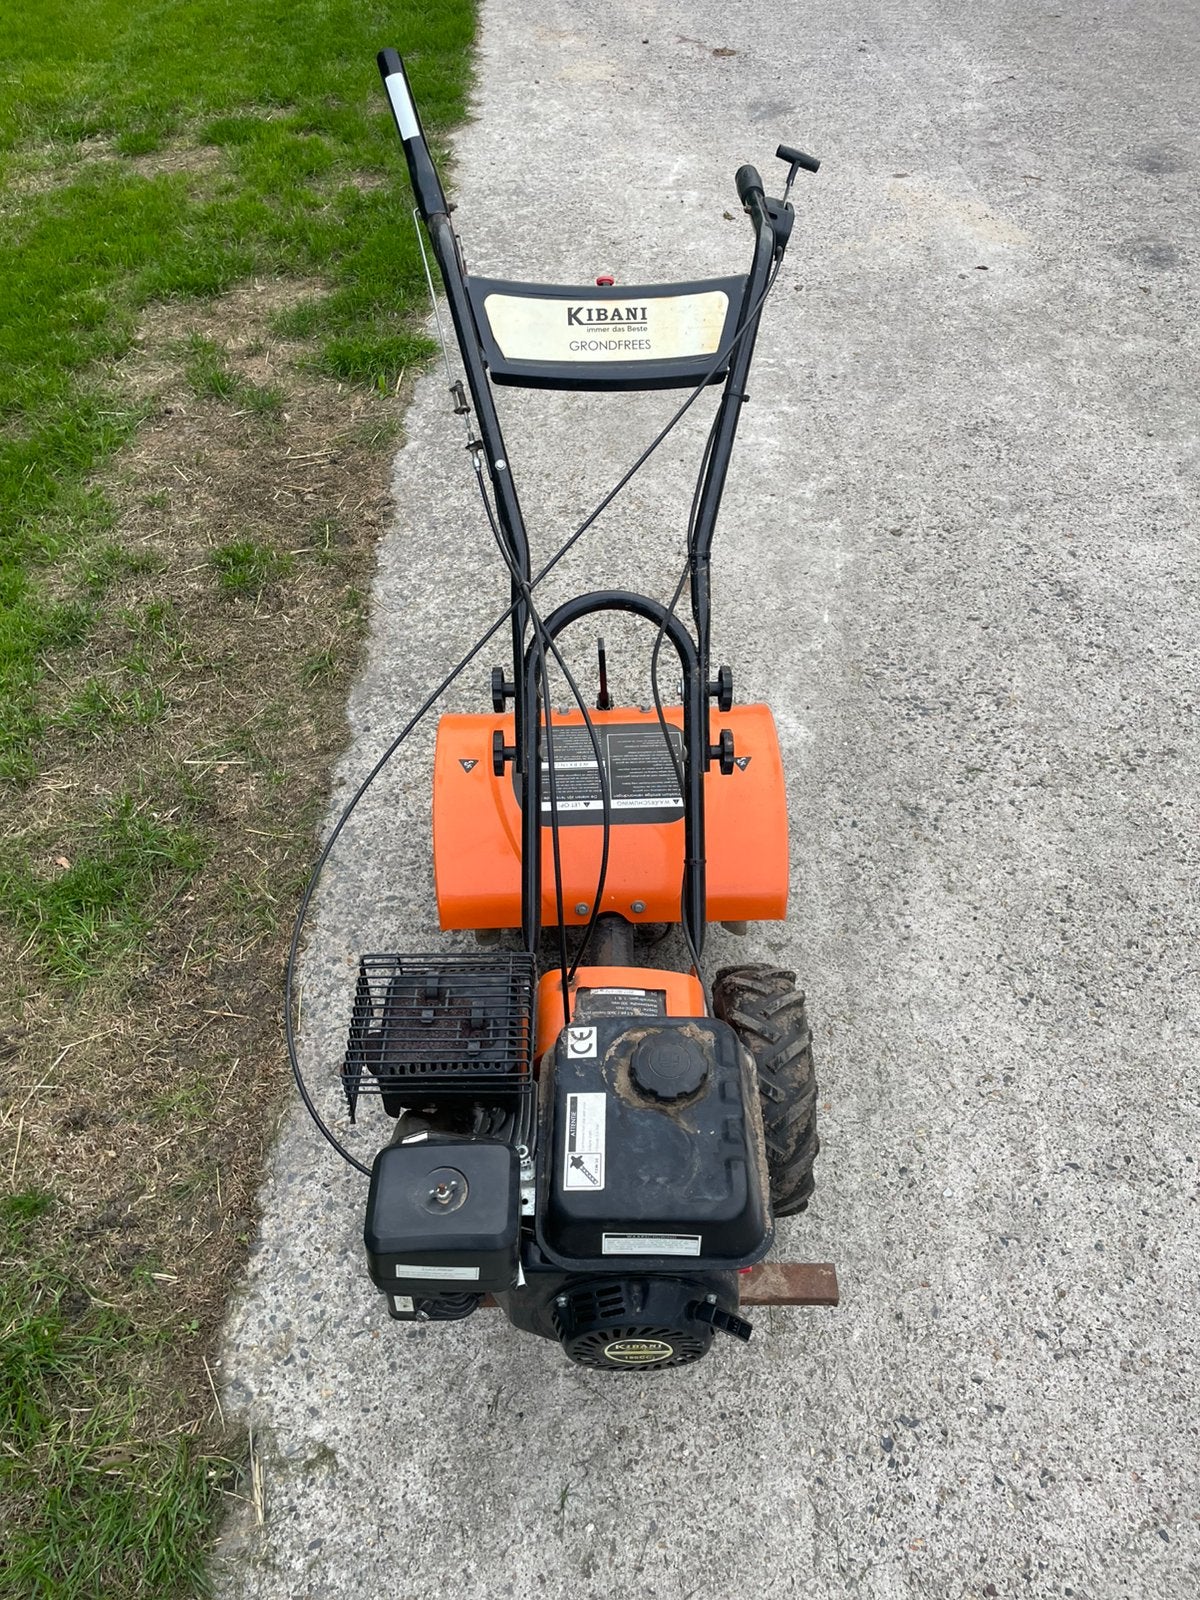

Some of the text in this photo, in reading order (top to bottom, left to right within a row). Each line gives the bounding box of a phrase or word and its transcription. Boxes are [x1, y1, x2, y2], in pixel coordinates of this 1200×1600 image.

[567, 306, 648, 325] KIBANI
[612, 325, 626, 333] das
[626, 325, 648, 333] Beste
[569, 339, 652, 352] GRONDFREES
